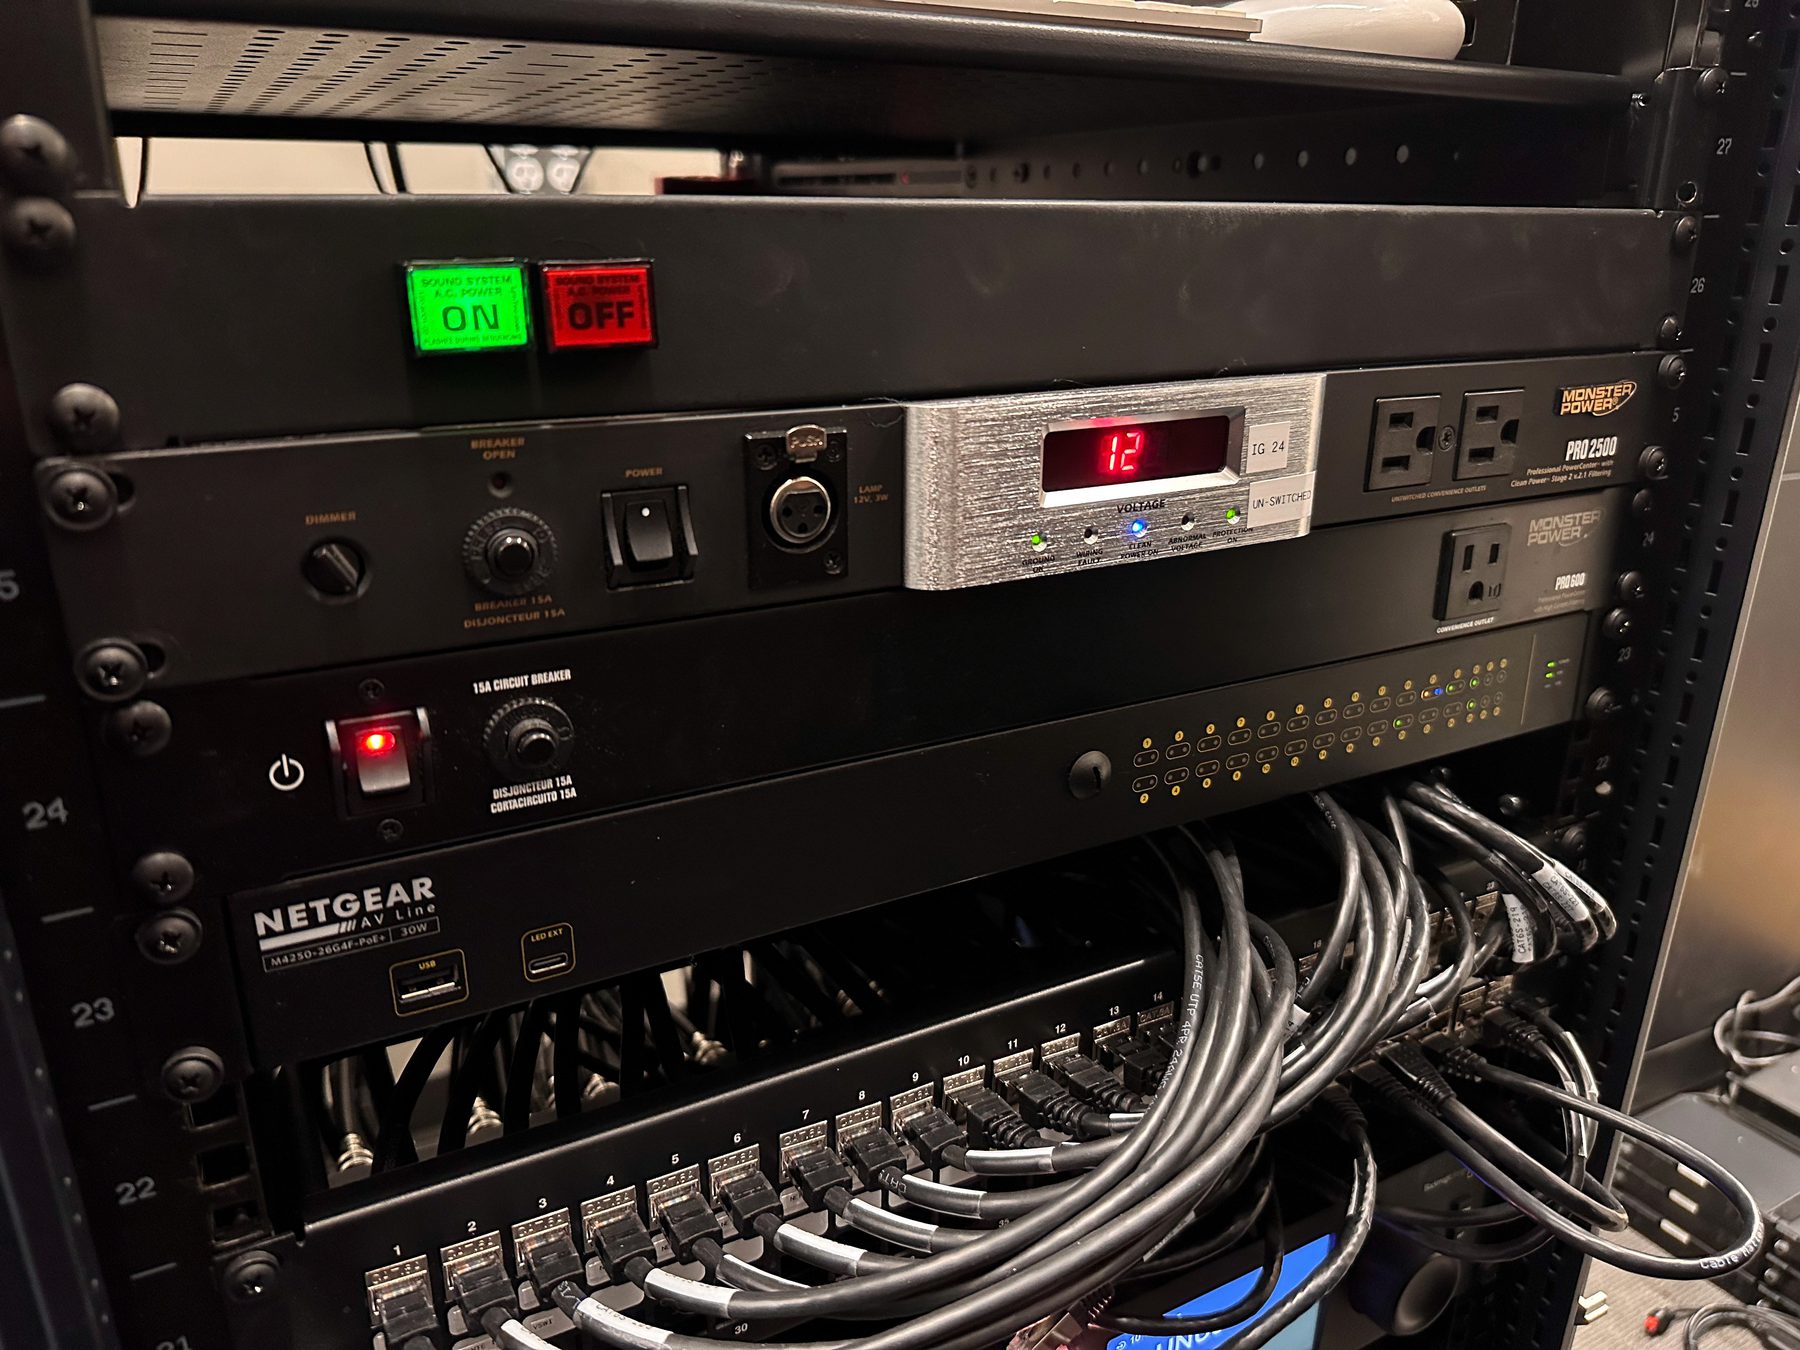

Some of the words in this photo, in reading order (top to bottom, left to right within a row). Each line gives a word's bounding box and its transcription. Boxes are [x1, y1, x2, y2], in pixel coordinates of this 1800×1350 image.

[1717, 138, 1733, 155] 27
[1690, 277, 1705, 294] 26
[442, 304, 499, 331] ON
[568, 301, 634, 330] OFF
[1562, 384, 1632, 402] MONSTER
[470, 437, 525, 449] BREAKER
[1252, 442, 1265, 455] IG
[1272, 441, 1285, 453] 24
[1565, 438, 1588, 461] PRO
[1588, 436, 1618, 459] 2500
[483, 450, 515, 460] OPEN
[625, 467, 663, 478] POWER
[1510, 480, 1527, 488] Clean
[1551, 474, 1568, 483] Stage
[1588, 469, 1612, 478] Filtering
[859, 484, 883, 493] LAMP
[1117, 499, 1165, 514] VOLTAGE
[1252, 490, 1312, 509] UN-SWITCHED
[305, 512, 357, 525] DIMMER
[1529, 510, 1601, 532] MONSTER
[1168, 533, 1206, 545] ABNORMAL
[1212, 527, 1253, 538] PROTECTION
[1527, 526, 1582, 546] POWER
[1129, 541, 1152, 550] CLEAN
[1171, 542, 1203, 552] VOLTAGE
[1022, 555, 1055, 566] GROUND
[1120, 551, 1147, 560] POWER
[1555, 574, 1570, 590] PRO
[1570, 572, 1586, 588] 600
[474, 598, 527, 612] BREAKER
[531, 594, 553, 605] 15A
[464, 611, 540, 628] DISJONCTEUR
[544, 608, 566, 619] 15A
[1618, 647, 1631, 662] 23
[473, 680, 492, 695] 15A
[493, 674, 529, 692] CIRCUIT
[531, 668, 571, 686] BREAKER
[492, 778, 553, 800] DISJONCTEUR
[555, 774, 572, 787] 15A
[490, 790, 557, 814] CORTACIRCUITO
[559, 787, 577, 800] 15A
[22, 797, 68, 830] 24
[254, 876, 436, 937] NETGEAR
[360, 913, 385, 929] AV
[395, 903, 436, 921] Line
[401, 922, 428, 937] 30W
[530, 931, 546, 943] LED
[547, 928, 563, 940] EXT
[1510, 906, 1527, 954] CAT6S-219
[419, 960, 436, 971] USB
[1153, 991, 1163, 1001] 14
[1109, 1005, 1120, 1016] 13
[1186, 994, 1200, 1016] UTP
[71, 997, 115, 1028] 23
[1055, 1023, 1066, 1034] 12
[1007, 1038, 1018, 1050] 11
[958, 1054, 970, 1066] 10
[912, 1072, 919, 1082] 9
[858, 1091, 866, 1100] 8
[802, 1109, 810, 1120] 7
[733, 1132, 742, 1143] 6
[671, 1154, 680, 1164] 5
[606, 1175, 615, 1186] 4
[115, 1176, 158, 1206] 22
[538, 1197, 548, 1209] 3
[467, 1221, 477, 1232] 2
[393, 1245, 401, 1256] 1
[735, 1323, 748, 1335] 30
